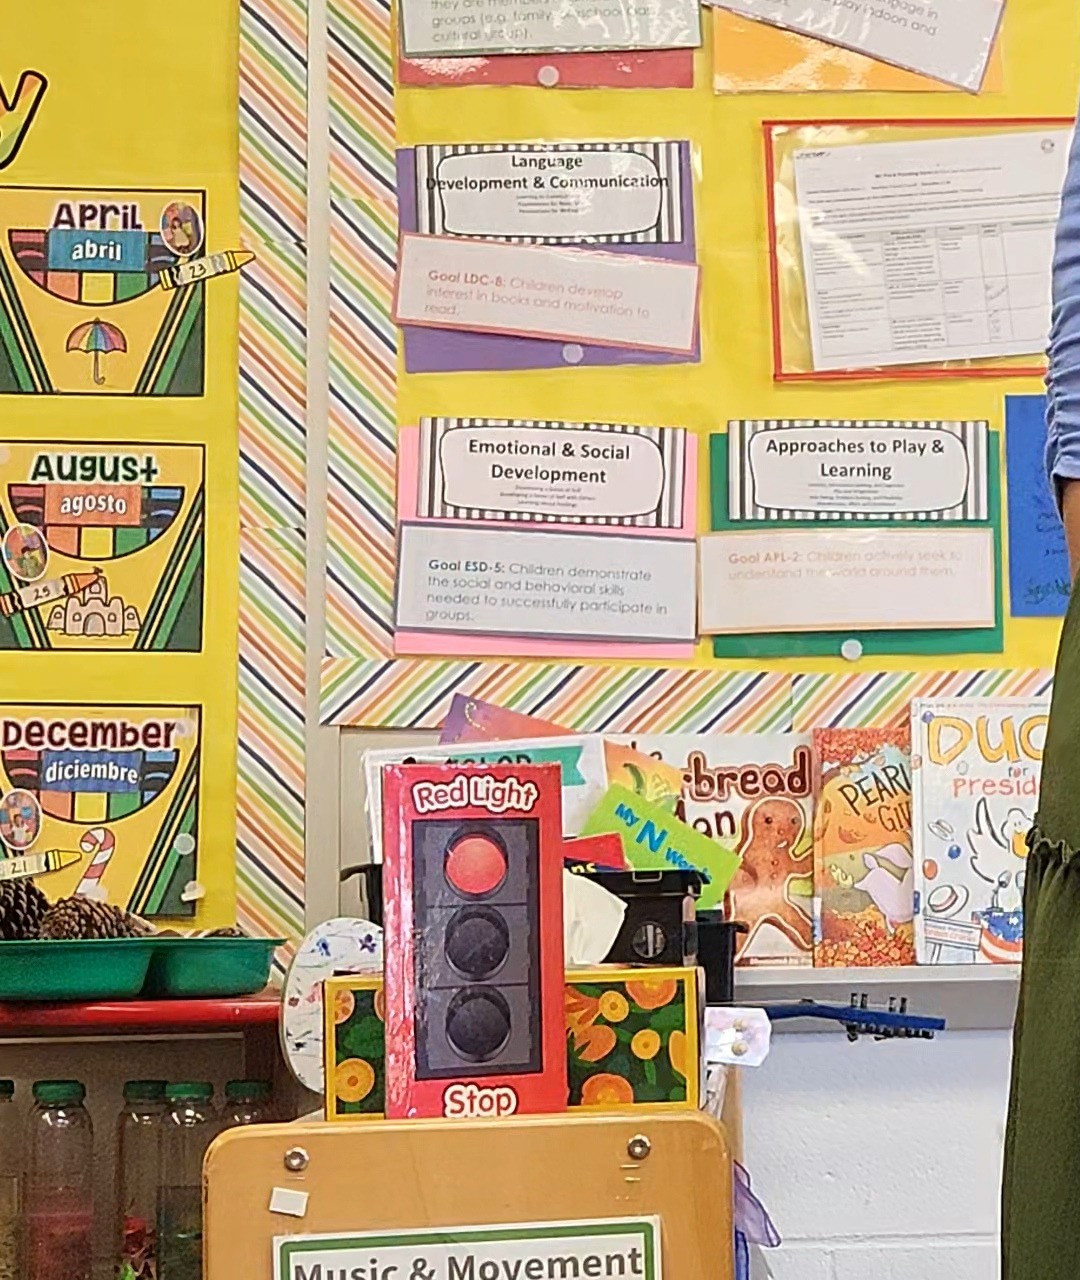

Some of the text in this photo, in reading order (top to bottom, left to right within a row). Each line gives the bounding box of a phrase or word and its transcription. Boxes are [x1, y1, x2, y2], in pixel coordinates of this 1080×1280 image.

[511, 155, 583, 171] Language
[426, 174, 669, 194] Development & Communication
[72, 239, 121, 261] abril
[428, 270, 461, 284] Goal
[510, 276, 564, 293] Children
[568, 283, 623, 300] develop
[469, 439, 630, 460] Emotional & Social
[766, 438, 945, 458] Approaches to Play &
[491, 464, 607, 484] Development
[820, 461, 892, 480] Learning
[60, 494, 127, 516] agosto
[428, 559, 461, 571] Goal
[509, 563, 564, 577] Children
[568, 566, 652, 581] demonstrate
[34, 588, 50, 601] 25
[428, 576, 624, 596] the social and behavioral skills
[427, 592, 667, 615] needed to successfully participate in
[46, 760, 138, 784] diciembre
[415, 776, 537, 812] Red Light
[614, 803, 640, 827] My
[636, 820, 668, 853] N
[12, 861, 27, 874] 21
[445, 1085, 516, 1117] Stop
